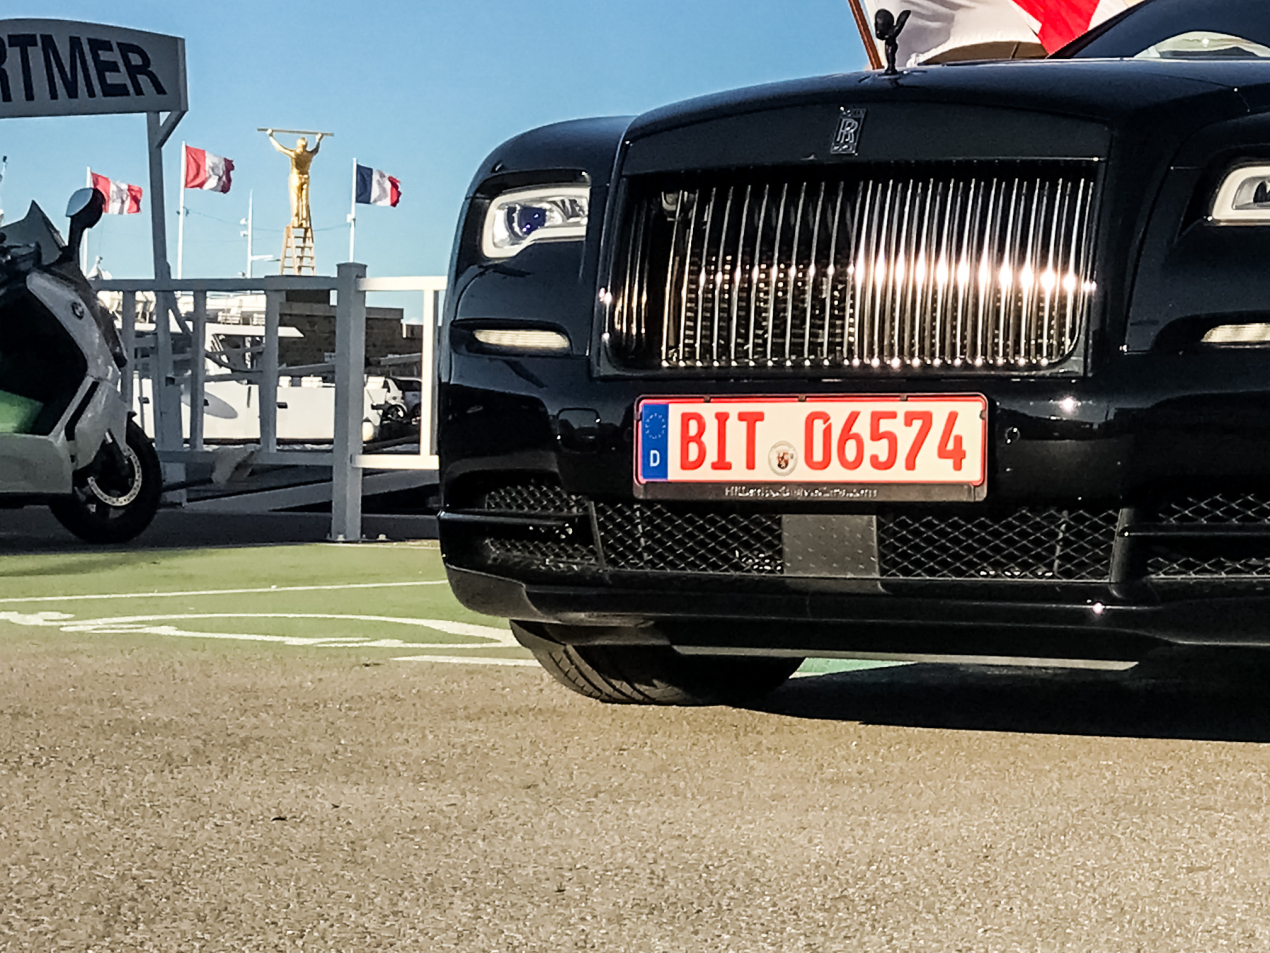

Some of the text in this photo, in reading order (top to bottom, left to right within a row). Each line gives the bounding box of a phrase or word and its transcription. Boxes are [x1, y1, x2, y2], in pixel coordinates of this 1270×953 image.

[0, 34, 168, 102] TMER
[650, 450, 660, 467] D
[679, 410, 967, 472] BIT 06574
